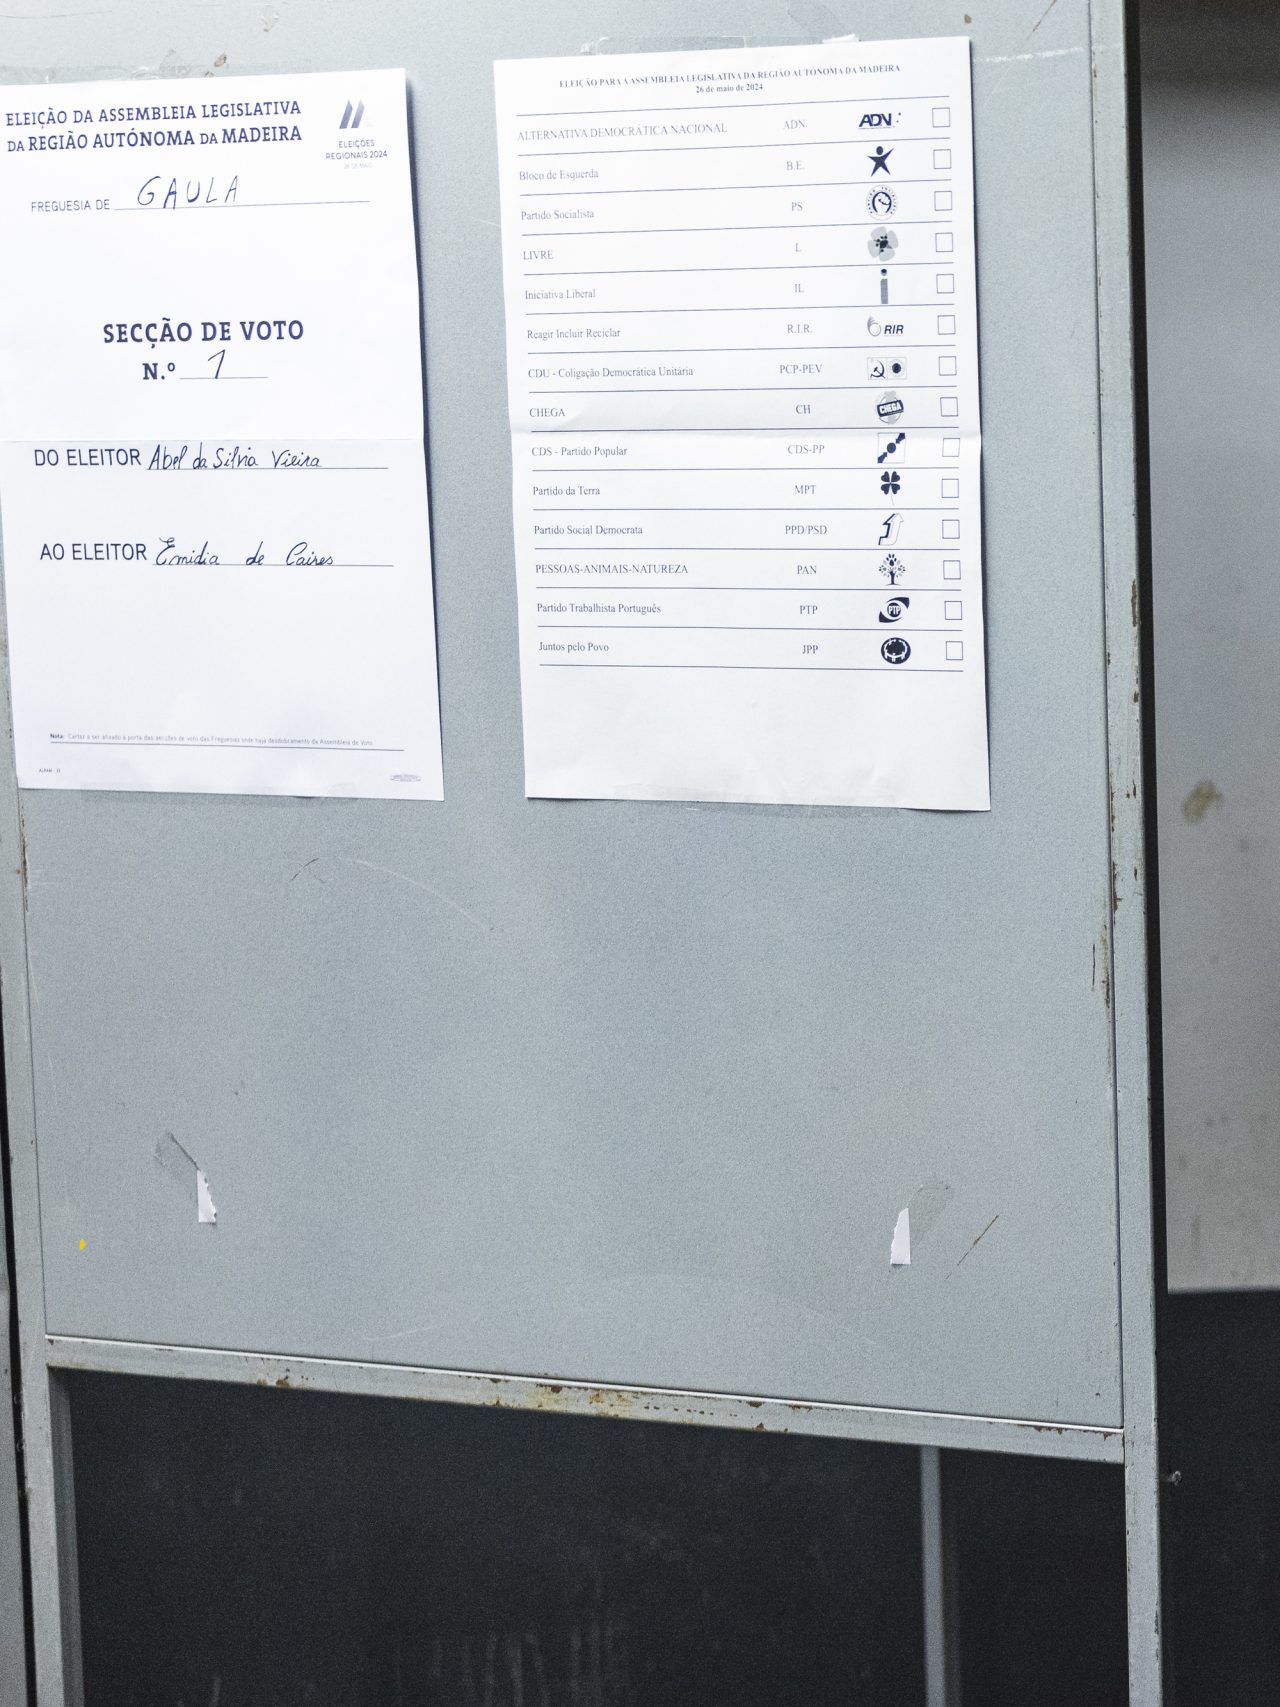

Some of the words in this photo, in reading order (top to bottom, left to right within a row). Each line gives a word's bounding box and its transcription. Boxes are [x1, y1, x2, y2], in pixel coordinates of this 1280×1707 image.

[560, 78, 598, 88] ELEIÇÃO
[600, 78, 621, 86] PARA
[687, 72, 742, 83] LEGISLATIVA
[744, 72, 756, 80] DA
[758, 68, 790, 78] REGIÃO
[846, 66, 856, 74] DA
[859, 64, 900, 74] MADEIRA
[706, 85, 714, 93] de
[716, 84, 734, 92] maio
[746, 83, 764, 91] 2024
[6, 109, 68, 128] ELEIÇÃO
[73, 109, 94, 124] DA
[98, 105, 196, 122] ASSEMBLEIA
[202, 100, 302, 118] LEGISLATIVA
[784, 120, 807, 130] ADN
[859, 113, 892, 128] ADN
[518, 128, 588, 140] ALTERNATIVA
[590, 123, 668, 138] DEMOCRÁTICA
[671, 121, 728, 134] NACIONAL
[8, 140, 26, 152] DA
[28, 132, 88, 152] REGIÃO
[92, 128, 196, 148] AUTÓNOMA
[200, 132, 218, 144] DA
[222, 126, 302, 143] MADEIRA
[338, 138, 376, 151] ELEIÇÕES
[326, 151, 368, 160] REGIONAIS
[370, 150, 388, 158] 2024
[786, 160, 805, 171] B.E.
[519, 170, 544, 180] Bloco
[546, 170, 558, 180] de
[560, 168, 599, 182] Esquerda
[137, 176, 239, 210] GAULA
[31, 200, 92, 212] FREGUESIA
[95, 199, 110, 211] DE
[791, 201, 804, 212] PS
[520, 210, 552, 220] Partido
[554, 208, 594, 220] Socialista
[795, 242, 802, 252] L
[522, 250, 554, 260] LIVRE
[524, 289, 563, 300] Iniciativa
[565, 288, 596, 299] Liberal
[794, 284, 804, 293] IL
[103, 316, 193, 349] SECÇÃO
[200, 322, 232, 342] DE
[240, 320, 304, 340] VOTO
[528, 329, 554, 341] Reagir
[556, 328, 584, 338] Incluir
[586, 328, 622, 338] Reciclar
[786, 324, 813, 334] R.I.R.
[884, 324, 904, 334] RIR
[528, 368, 550, 379] CDU
[558, 368, 600, 381] Coligação
[602, 367, 656, 377] Democrática
[658, 366, 694, 376] Unitária
[779, 364, 822, 375] PCP-PEV
[529, 407, 566, 418] CHEGA
[795, 404, 811, 414] CH
[532, 446, 552, 456] CDS
[561, 446, 592, 456] Partido
[594, 446, 628, 458] Popular
[788, 444, 825, 454] CDS-PP
[34, 448, 59, 466] DO
[66, 448, 142, 466] ELEITOR
[148, 445, 188, 470] Abel
[192, 442, 208, 469] da
[271, 450, 322, 468] Vieira
[532, 486, 564, 496] Partido
[565, 486, 576, 496] da
[578, 486, 600, 496] Terra
[794, 484, 816, 495] MPT
[534, 525, 564, 535] Partido
[566, 524, 592, 535] Social
[596, 525, 643, 535] Democrata
[785, 524, 828, 535] PPD/PSD
[40, 543, 65, 560] AO
[72, 543, 148, 560] ELEITOR
[246, 541, 264, 566] de
[286, 542, 334, 566] Caires
[535, 564, 688, 575] PESSOAS-ANIMAIS-NATUREZA
[796, 564, 817, 575] PAN
[537, 603, 568, 613] Partido
[569, 602, 616, 613] Trabalhista
[618, 604, 662, 616] Português
[800, 604, 818, 615] PTP
[888, 605, 901, 614] PTP
[538, 642, 566, 652] Juntos
[568, 642, 586, 654] pelo
[588, 642, 610, 652] Povo
[802, 644, 819, 655] JPP
